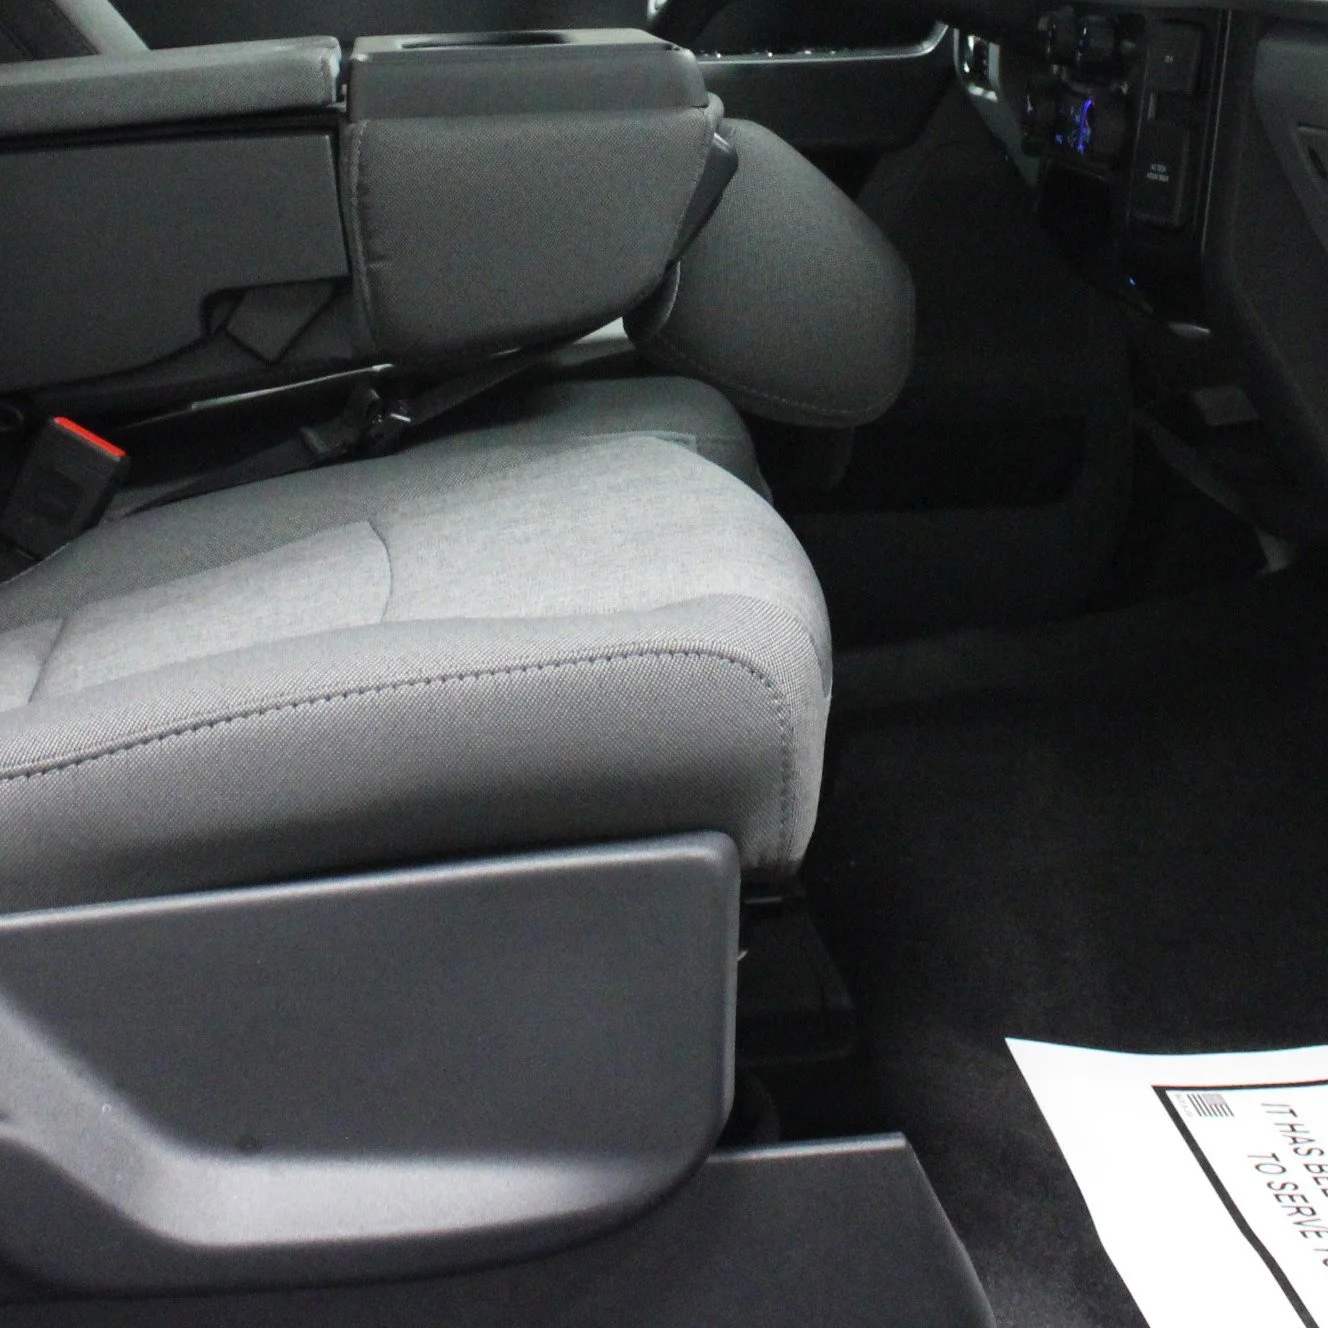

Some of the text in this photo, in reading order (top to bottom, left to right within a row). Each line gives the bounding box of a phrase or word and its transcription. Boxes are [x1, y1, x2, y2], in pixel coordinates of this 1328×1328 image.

[1261, 1102, 1298, 1118] IT
[1274, 1122, 1325, 1157] HAS
[1247, 1152, 1287, 1175] TO
